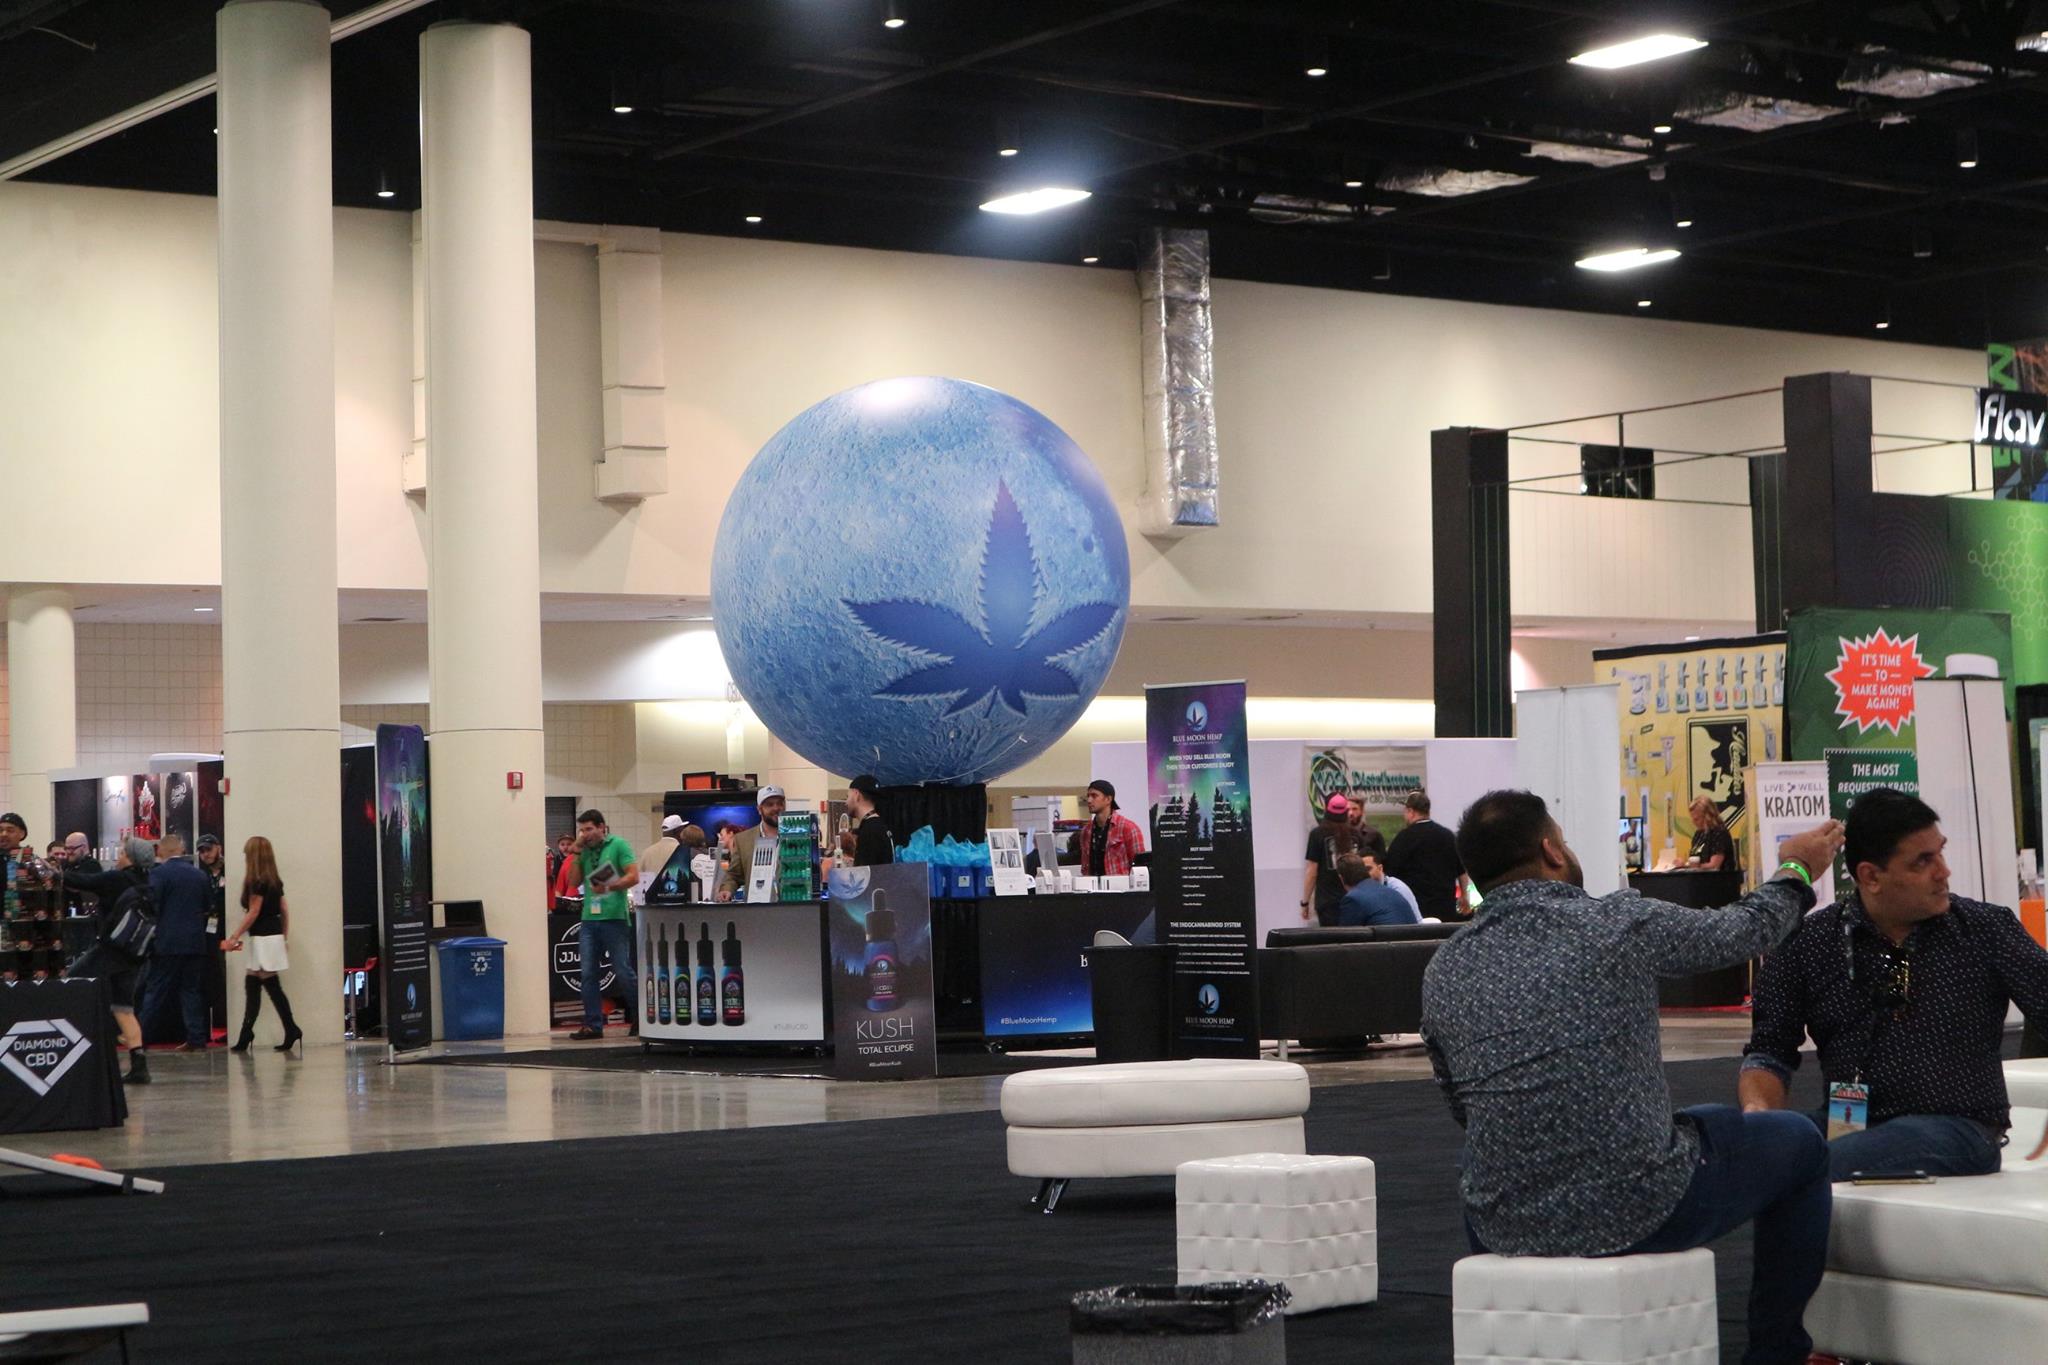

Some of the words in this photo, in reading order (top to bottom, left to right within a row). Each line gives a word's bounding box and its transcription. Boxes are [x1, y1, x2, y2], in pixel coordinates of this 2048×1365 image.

[1861, 654, 1876, 667] IT'S
[1879, 654, 1901, 667] TIME
[1875, 669, 1888, 682] TO
[1852, 684, 1877, 696] MAKE
[1880, 684, 1913, 697] MONEY
[1866, 698, 1900, 710] AGAIN!
[1172, 735, 1185, 743] BLUE
[1186, 734, 1206, 742] MOON
[1852, 763, 1871, 777] THE
[1873, 763, 1900, 777] MOST
[1764, 783, 1784, 793] LIVE
[1799, 782, 1824, 792] WELL
[1764, 795, 1825, 818] KRATOM
[559, 951, 582, 963] JJu
[1000, 1016, 1057, 1025] #BlueMoonHemp
[856, 1017, 914, 1039] KUSH
[14, 1038, 68, 1051] DIAMOND
[858, 1046, 882, 1055] TOTAL
[884, 1043, 914, 1054] ECLIPSE
[25, 1052, 58, 1067] CBD
